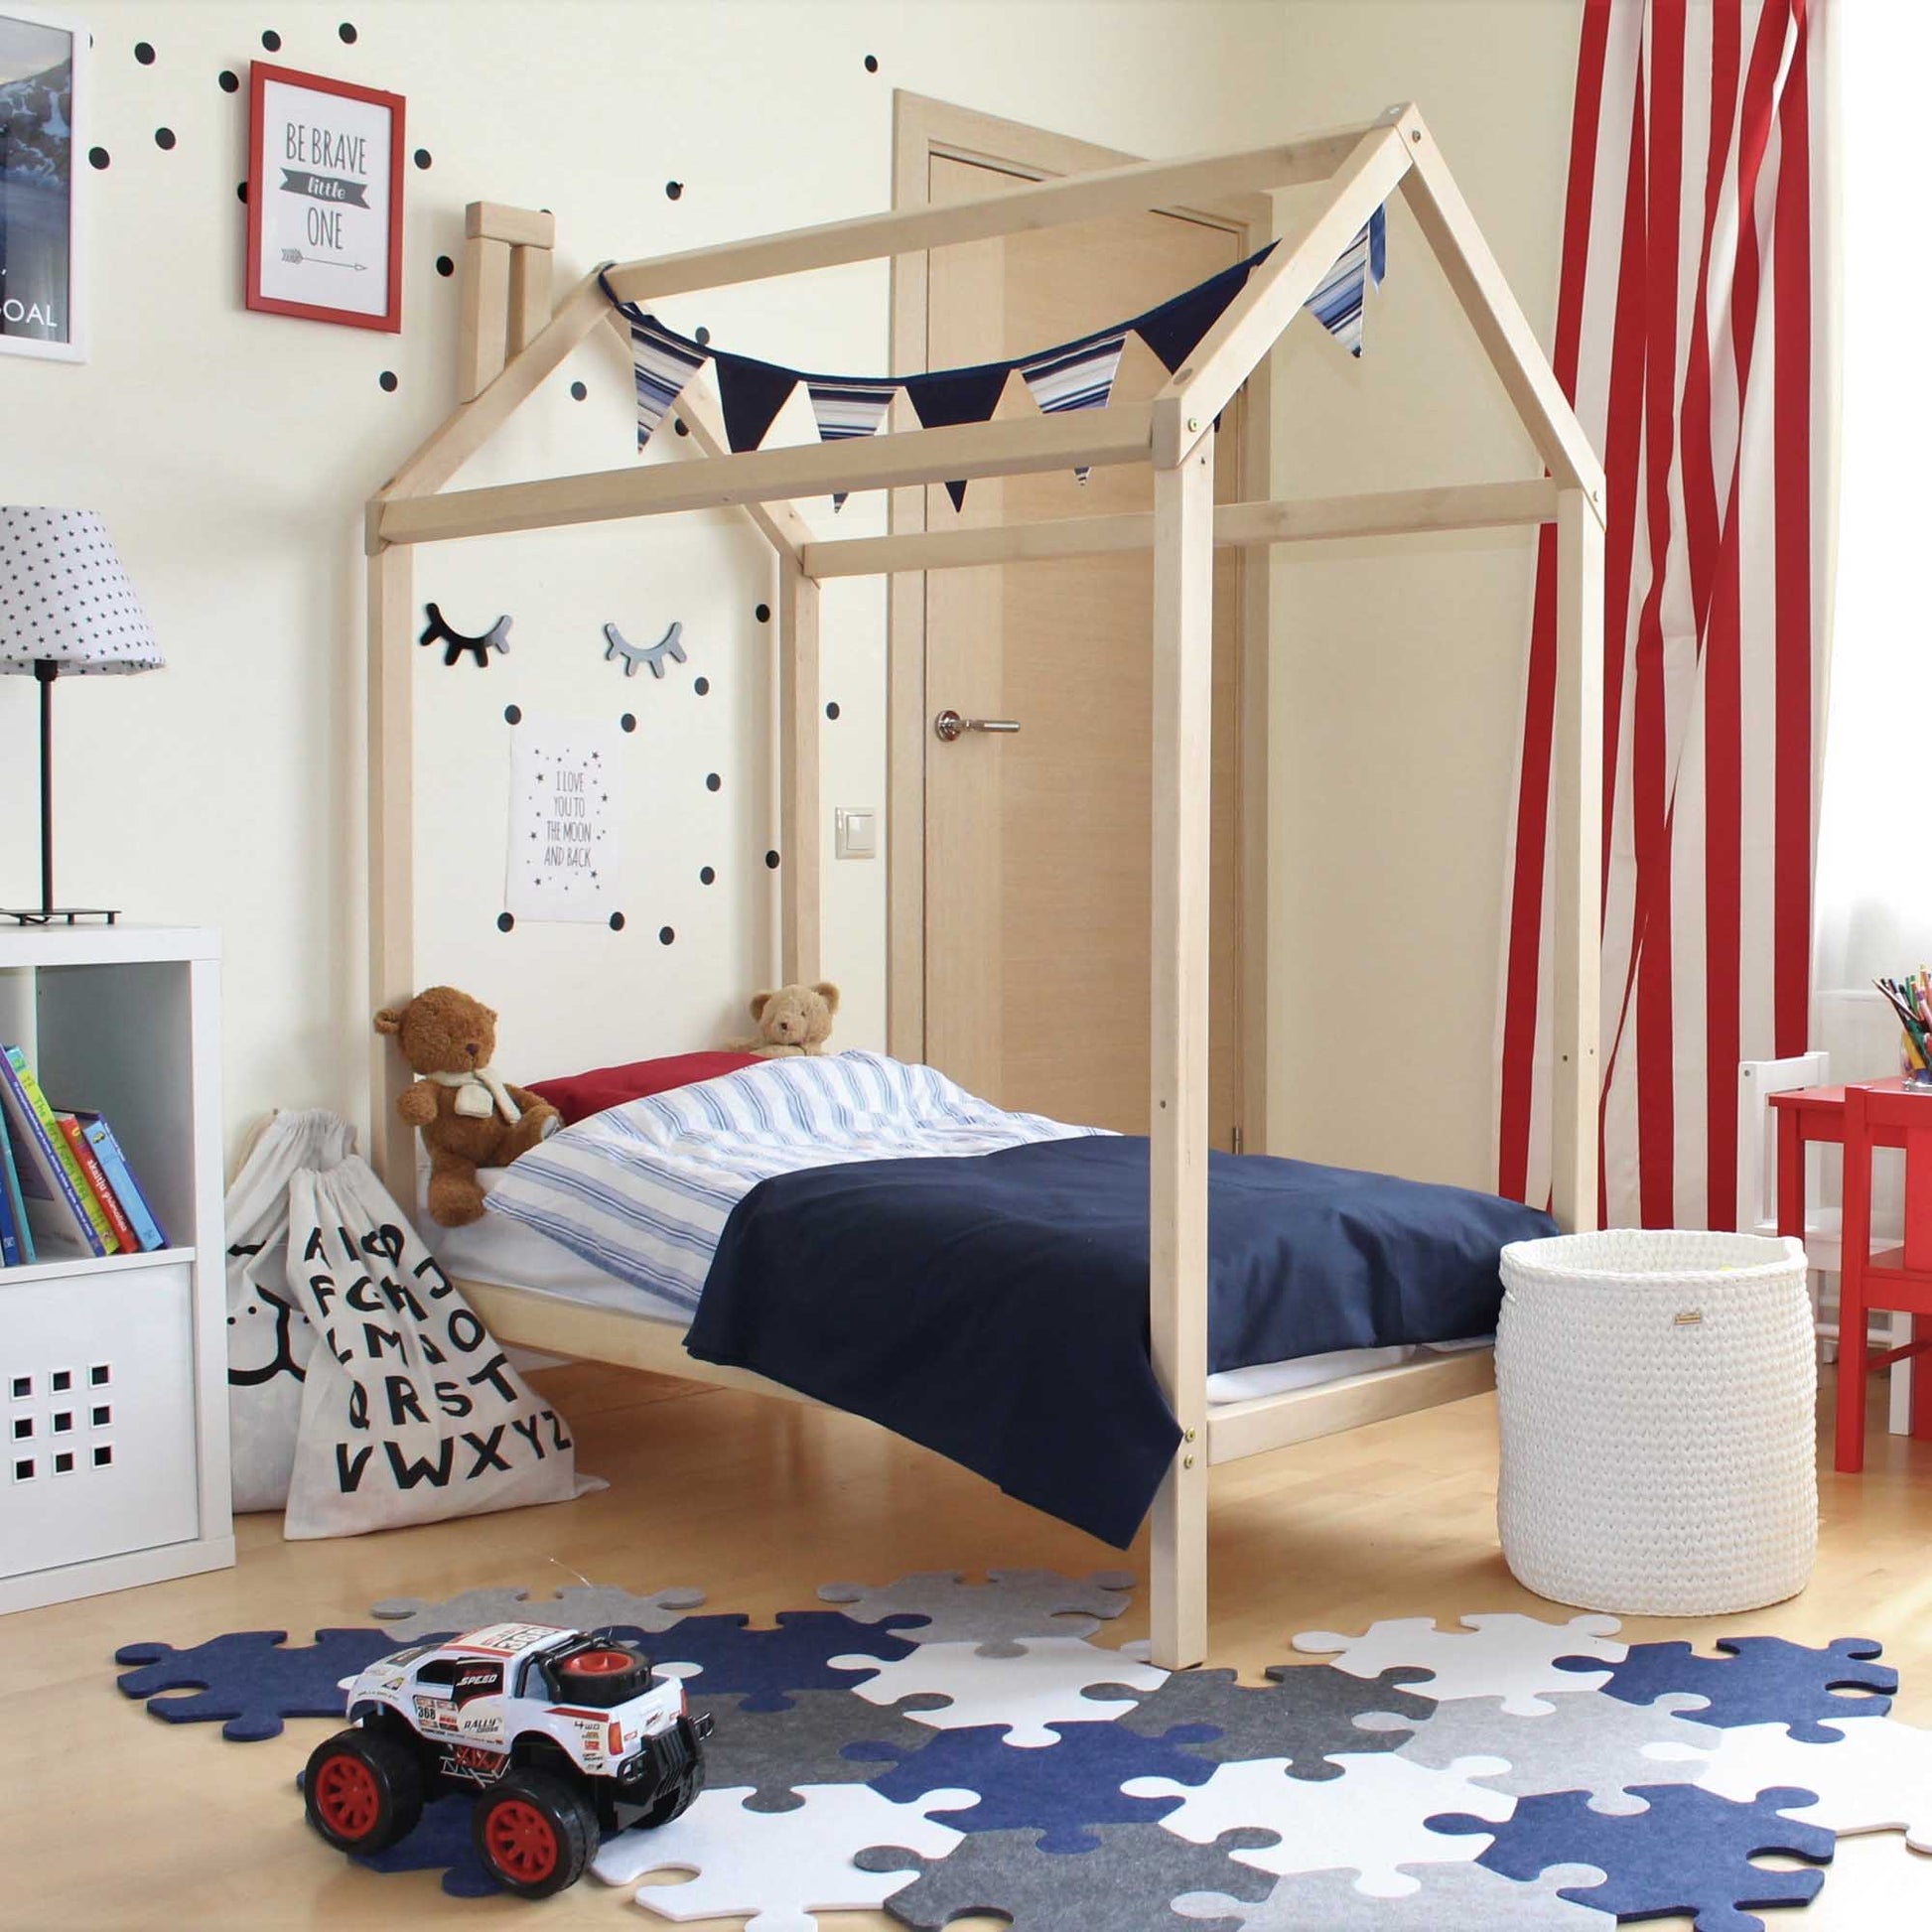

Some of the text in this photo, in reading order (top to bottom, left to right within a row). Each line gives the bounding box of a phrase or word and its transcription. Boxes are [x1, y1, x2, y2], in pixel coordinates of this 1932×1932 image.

[286, 122, 367, 175] BE BRAVE
[307, 176, 346, 200] little
[307, 207, 344, 249] ONE
[0, 299, 58, 327] OAL
[556, 770, 584, 792] I LOVE
[554, 796, 586, 818] YOU TO
[547, 820, 592, 842] THE MOON
[544, 846, 592, 868] AND BACK
[457, 1674, 498, 1686] SPEED
[465, 1718, 496, 1728] RALLY
[575, 1721, 601, 1730] 4WD
